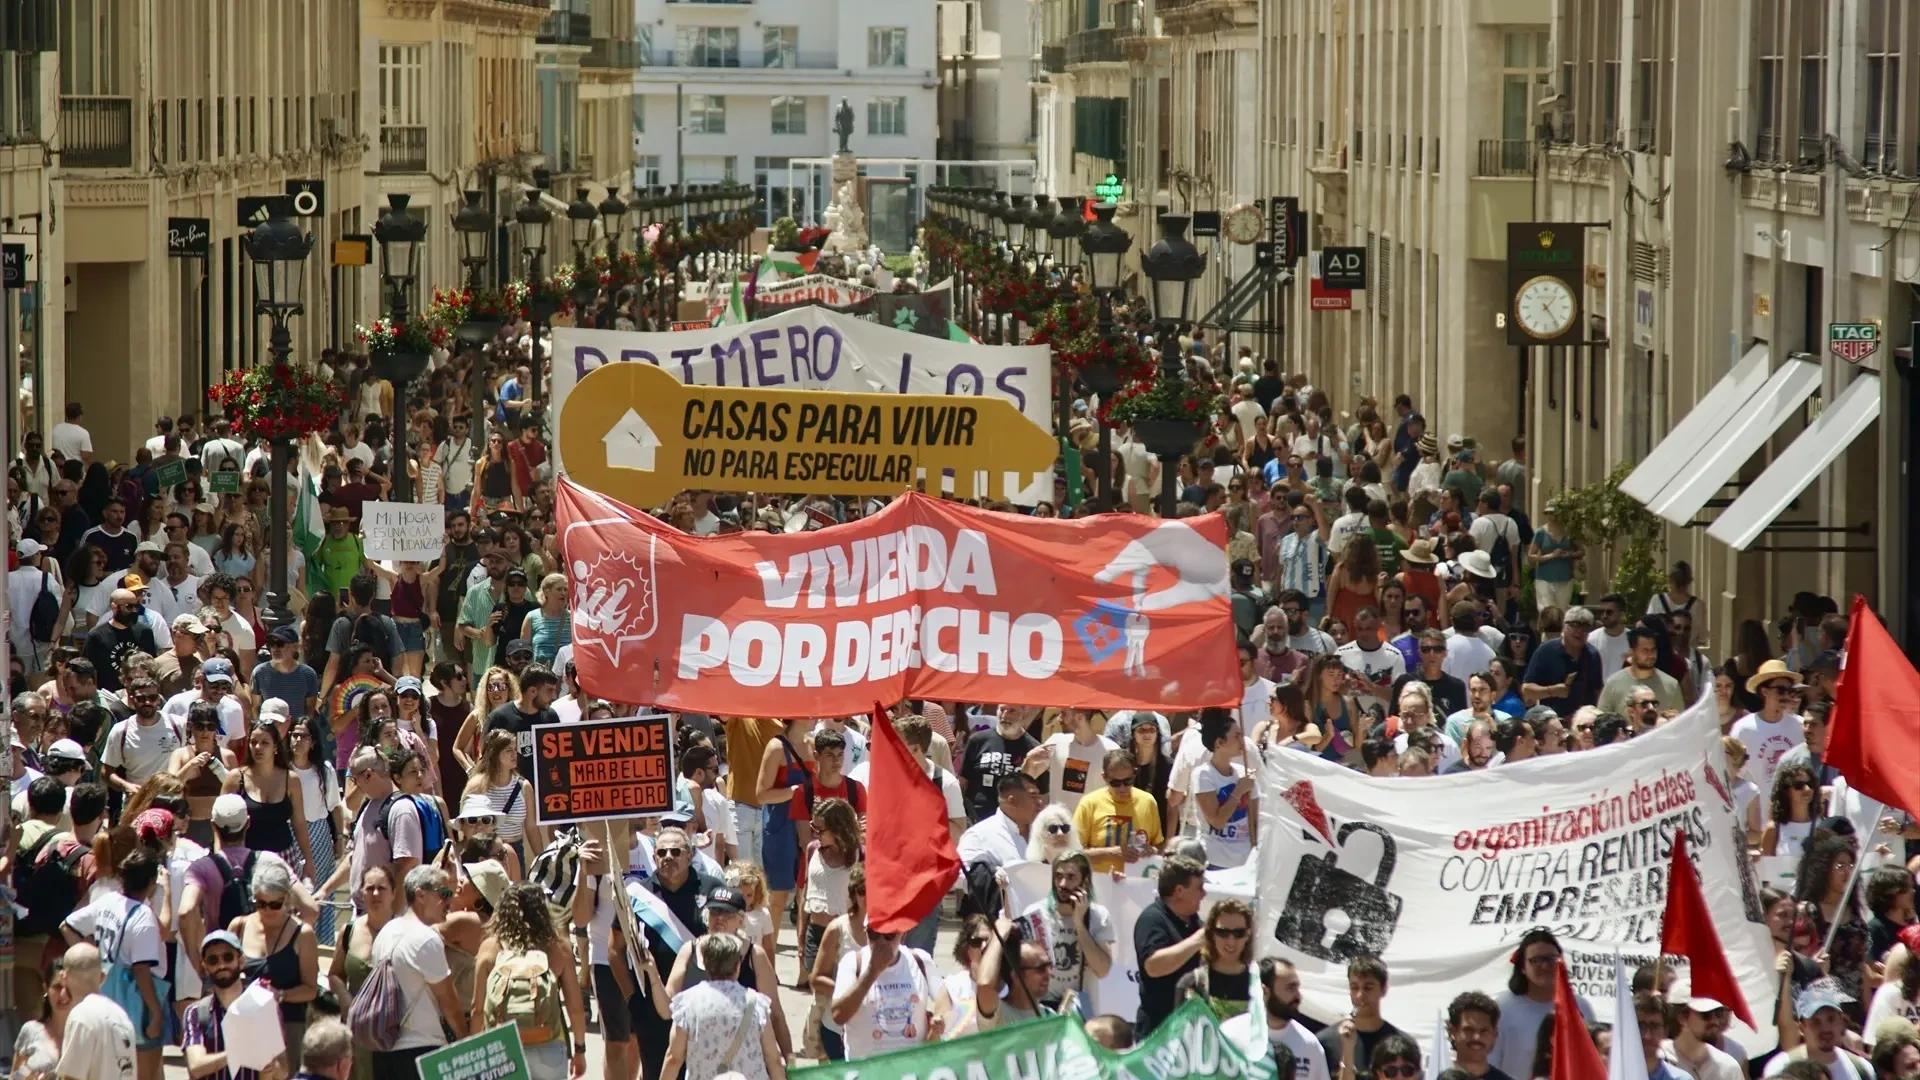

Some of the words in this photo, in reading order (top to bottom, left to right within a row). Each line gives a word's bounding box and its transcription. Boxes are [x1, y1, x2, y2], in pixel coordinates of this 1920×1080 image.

[1274, 201, 1287, 264] PRIMOR
[1328, 254, 1360, 269] AD
[1834, 326, 1873, 339] TAG
[1833, 341, 1874, 360] HEUER
[683, 398, 791, 442] CASAS
[796, 403, 882, 445] PARA
[893, 406, 978, 446] VIVIR
[683, 448, 716, 477] NO
[720, 449, 779, 480] PARA
[784, 452, 912, 483] ESPECULAR
[374, 539, 389, 550] DE
[754, 524, 997, 609] VIVIENDA
[677, 613, 828, 688] POR
[831, 604, 1064, 687] DERECHO
[542, 731, 573, 759] SE
[580, 724, 665, 756] VENDE
[574, 758, 666, 783] MARBELLA
[572, 789, 604, 811] SAN
[610, 785, 667, 807] PEDRO
[1453, 787, 1626, 860] organización
[1628, 778, 1652, 824] de
[1655, 768, 1697, 814] clase
[1439, 848, 1570, 893] CONTRA
[714, 889, 733, 899] ICON
[438, 1060, 451, 1074] EL
[452, 1048, 486, 1068] PRECIO
[486, 1040, 506, 1054] DEL
[443, 1060, 488, 1080] ALQUILER
[488, 1051, 508, 1066] NOS
[480, 1060, 517, 1080] FUTURO
